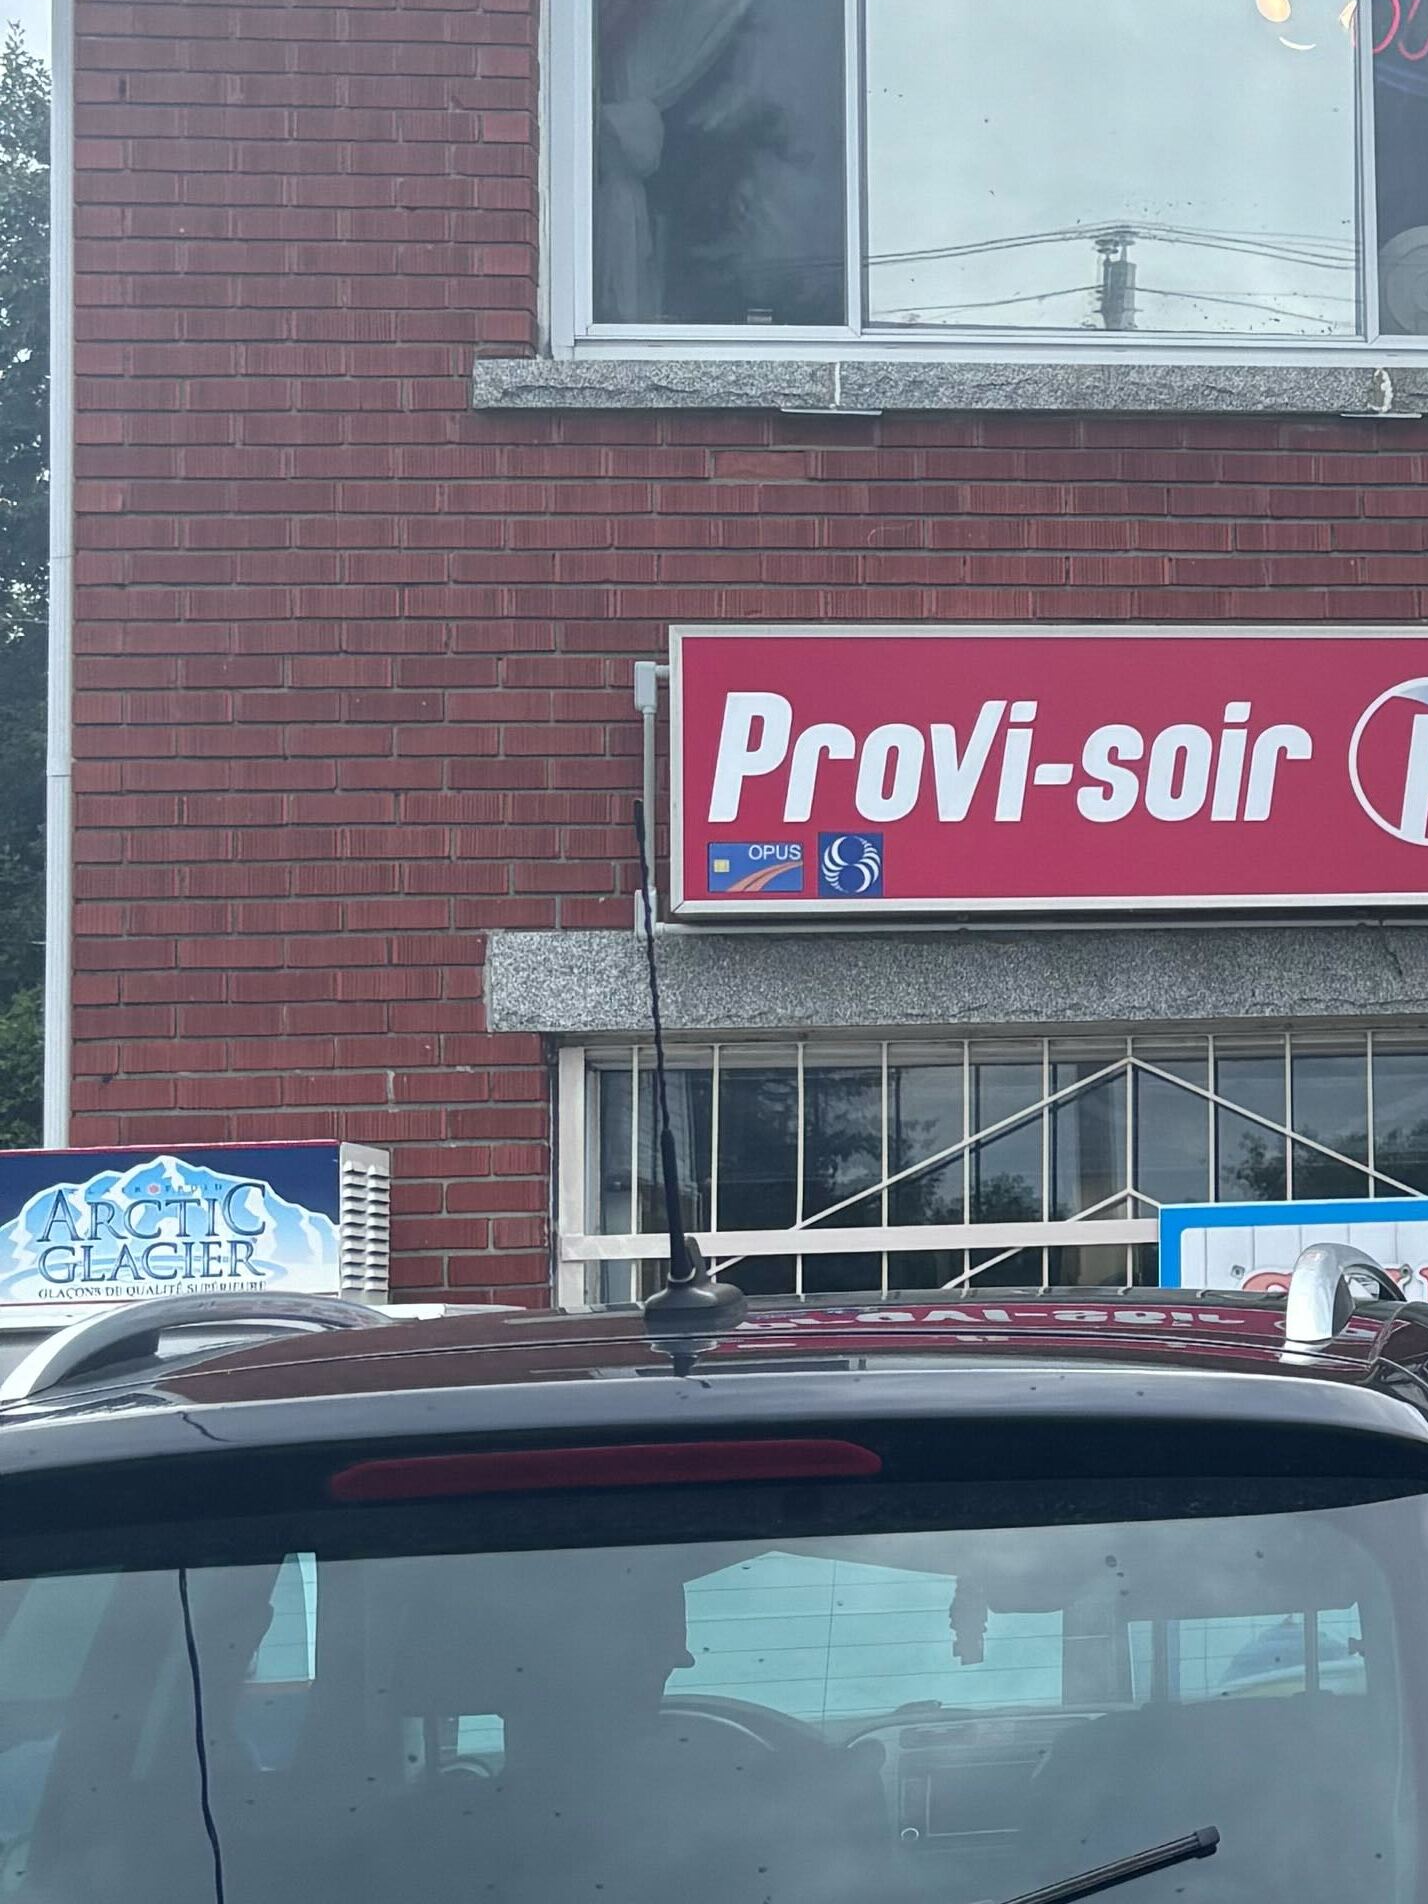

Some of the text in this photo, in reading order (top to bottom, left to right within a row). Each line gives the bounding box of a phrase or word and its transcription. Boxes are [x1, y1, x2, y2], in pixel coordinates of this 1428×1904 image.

[748, 843, 802, 861] OPUS
[37, 1183, 266, 1242] ARCTIC
[39, 1241, 266, 1283] GLACIER
[126, 1281, 182, 1296] QUALITÉ
